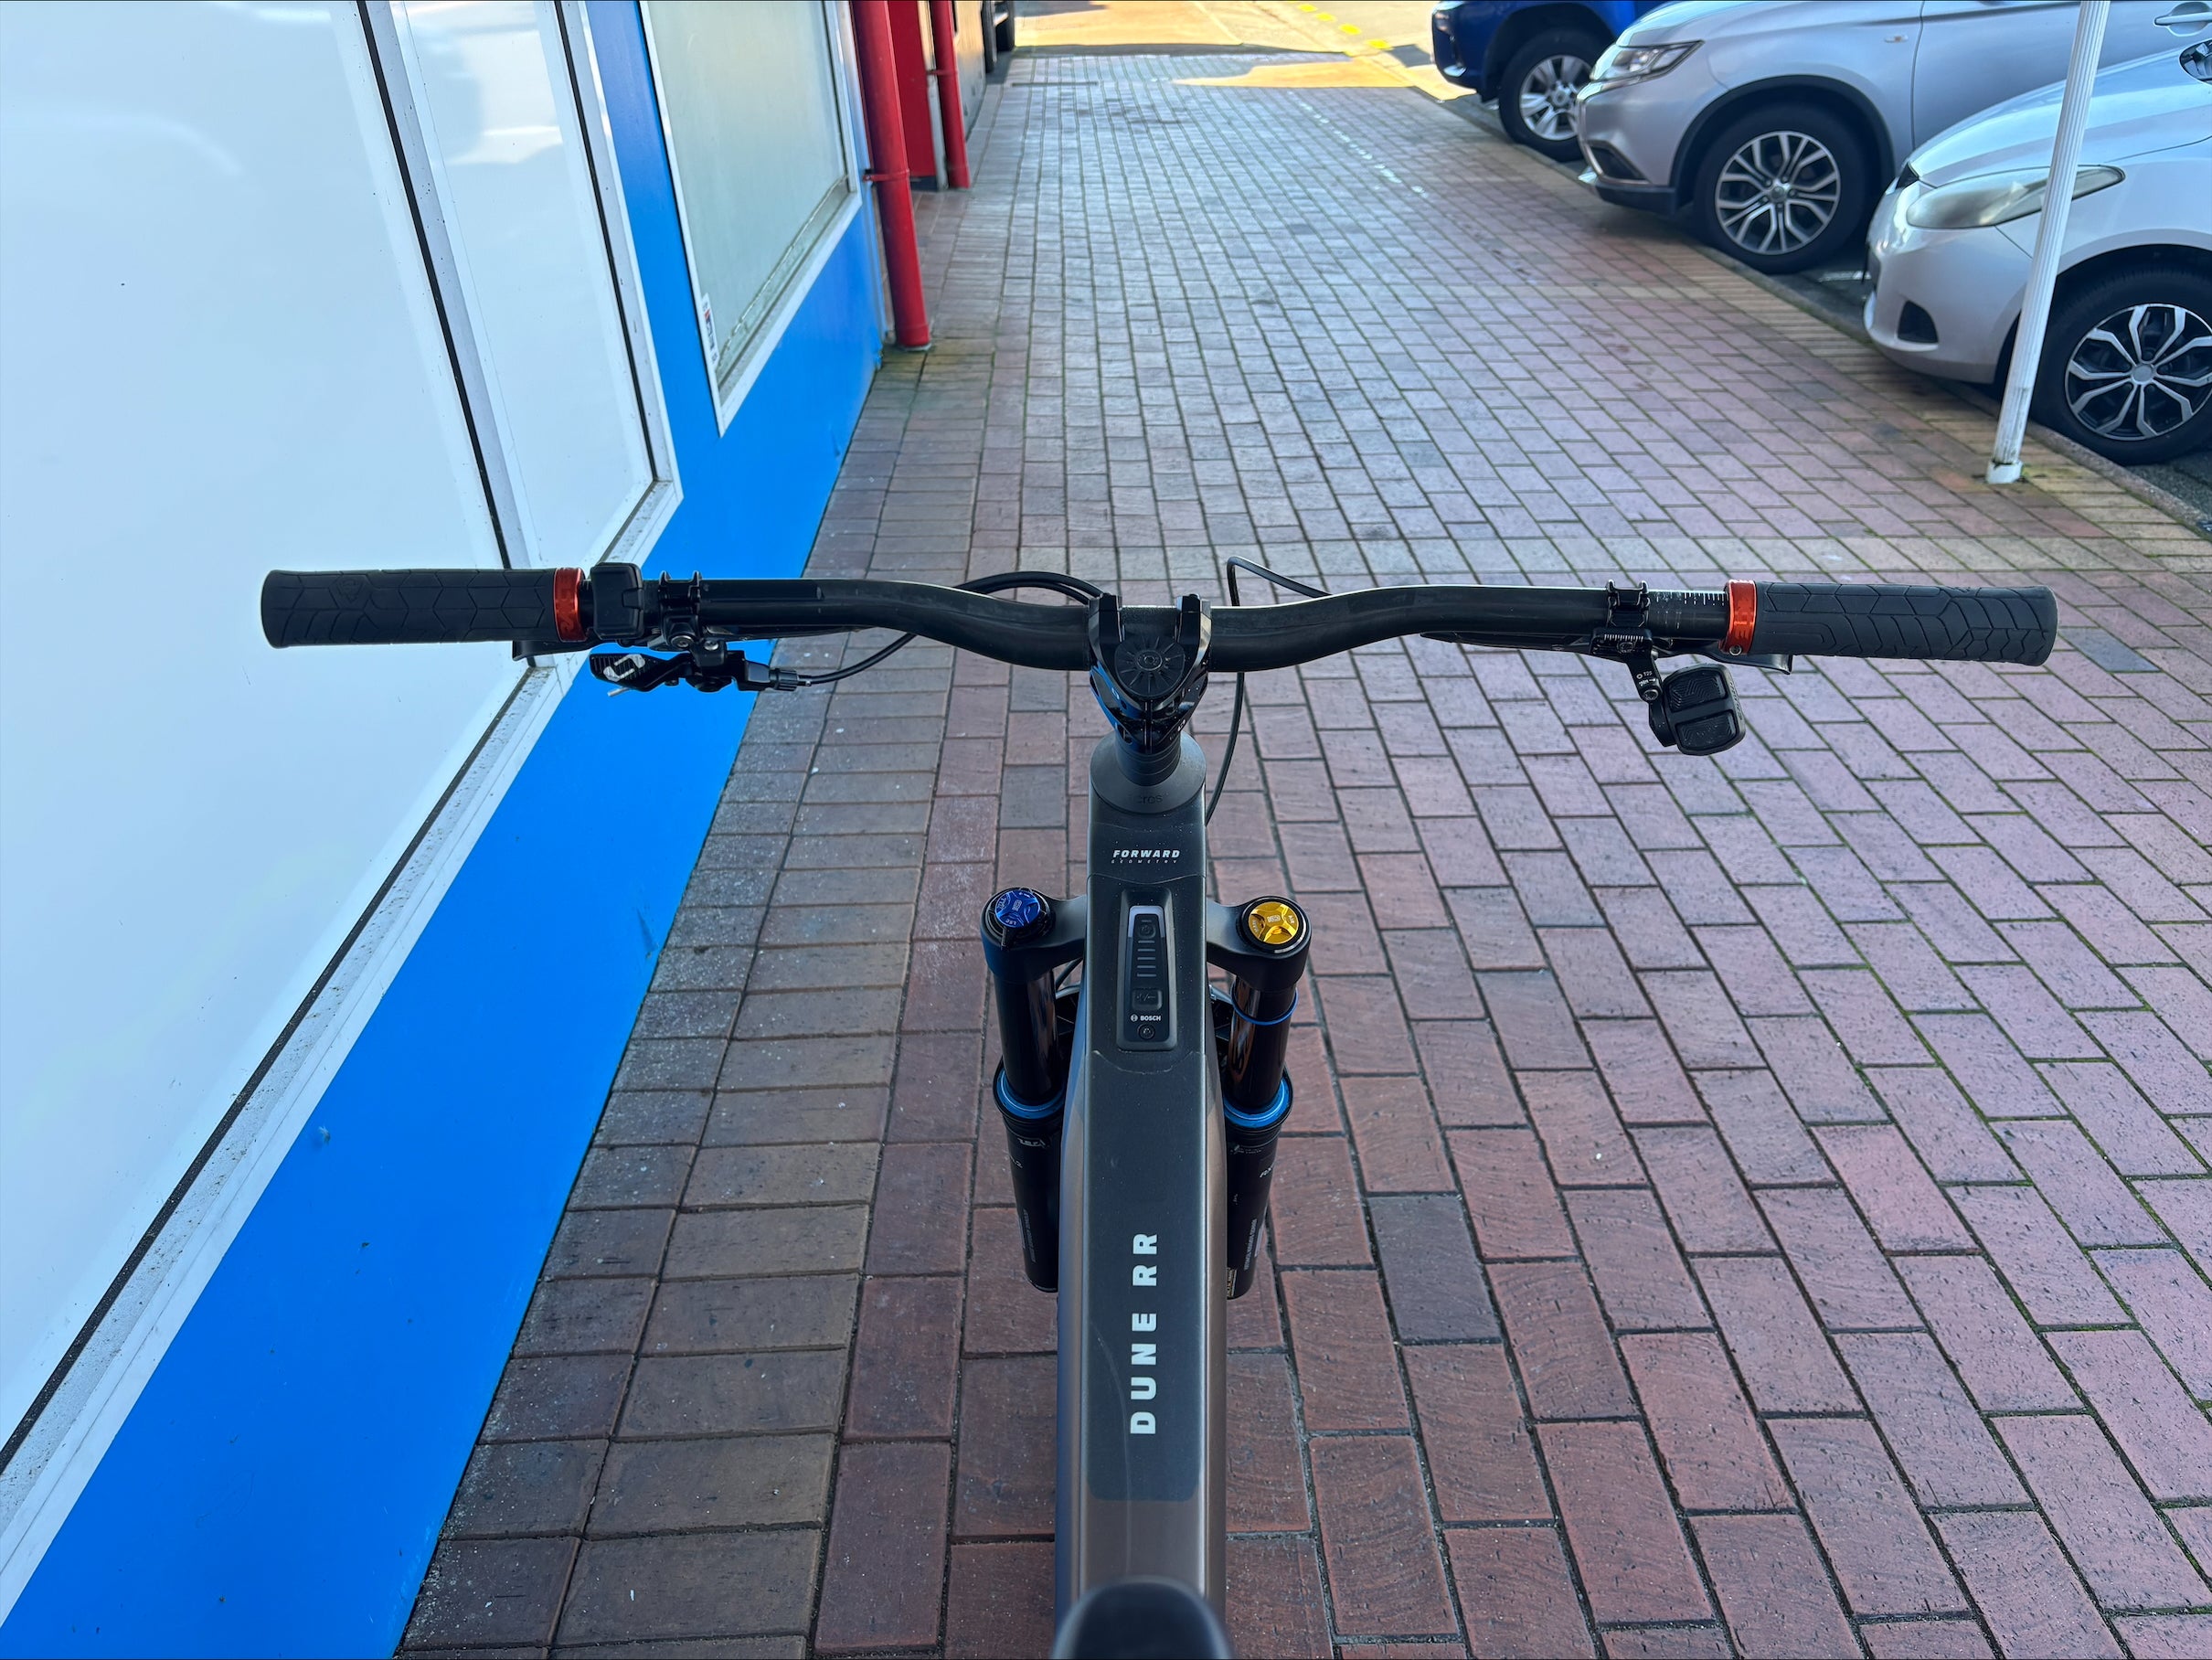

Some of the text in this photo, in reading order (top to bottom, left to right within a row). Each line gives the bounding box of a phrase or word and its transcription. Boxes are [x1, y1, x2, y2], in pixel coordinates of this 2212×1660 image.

[1112, 849, 1180, 858] FORWARD
[1130, 1233, 1158, 1434] DUNE RR
